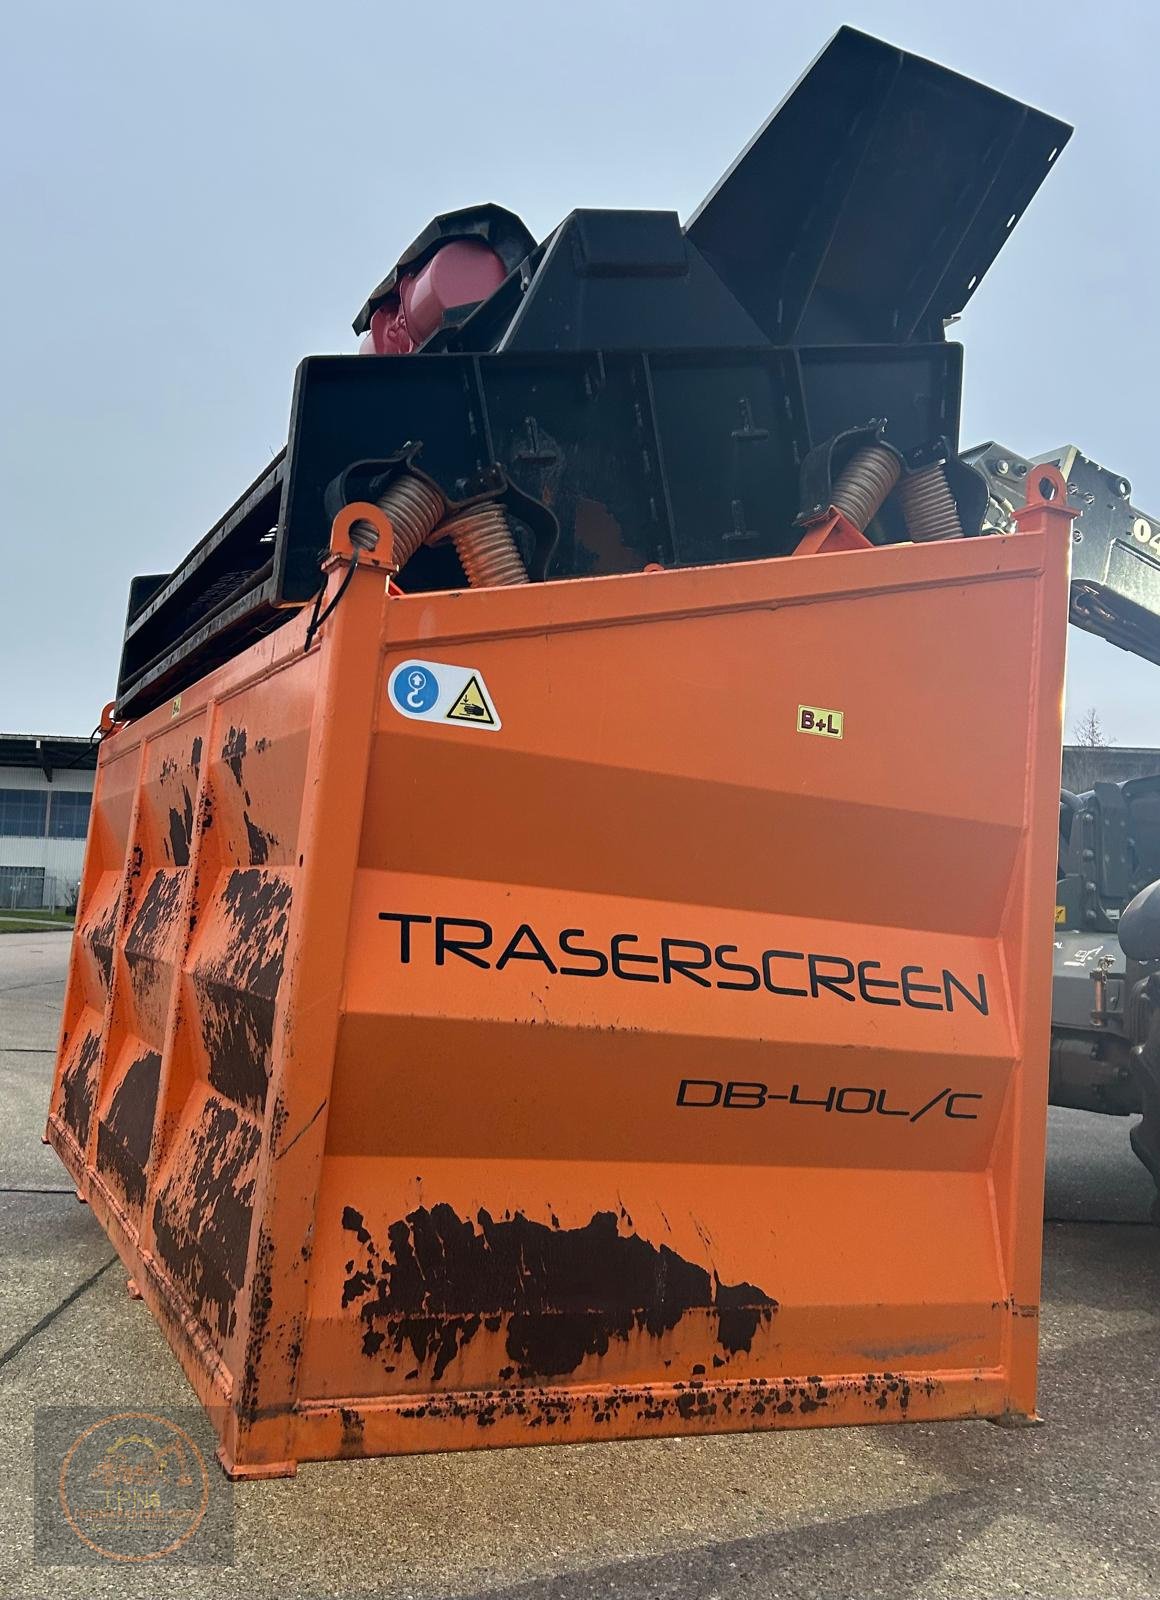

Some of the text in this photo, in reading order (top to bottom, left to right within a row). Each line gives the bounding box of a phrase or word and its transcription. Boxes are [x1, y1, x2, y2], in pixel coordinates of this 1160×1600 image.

[801, 709, 840, 735] B+L
[378, 911, 990, 1016] TRASERSCREEN
[675, 1079, 983, 1122] DB-40L/C
